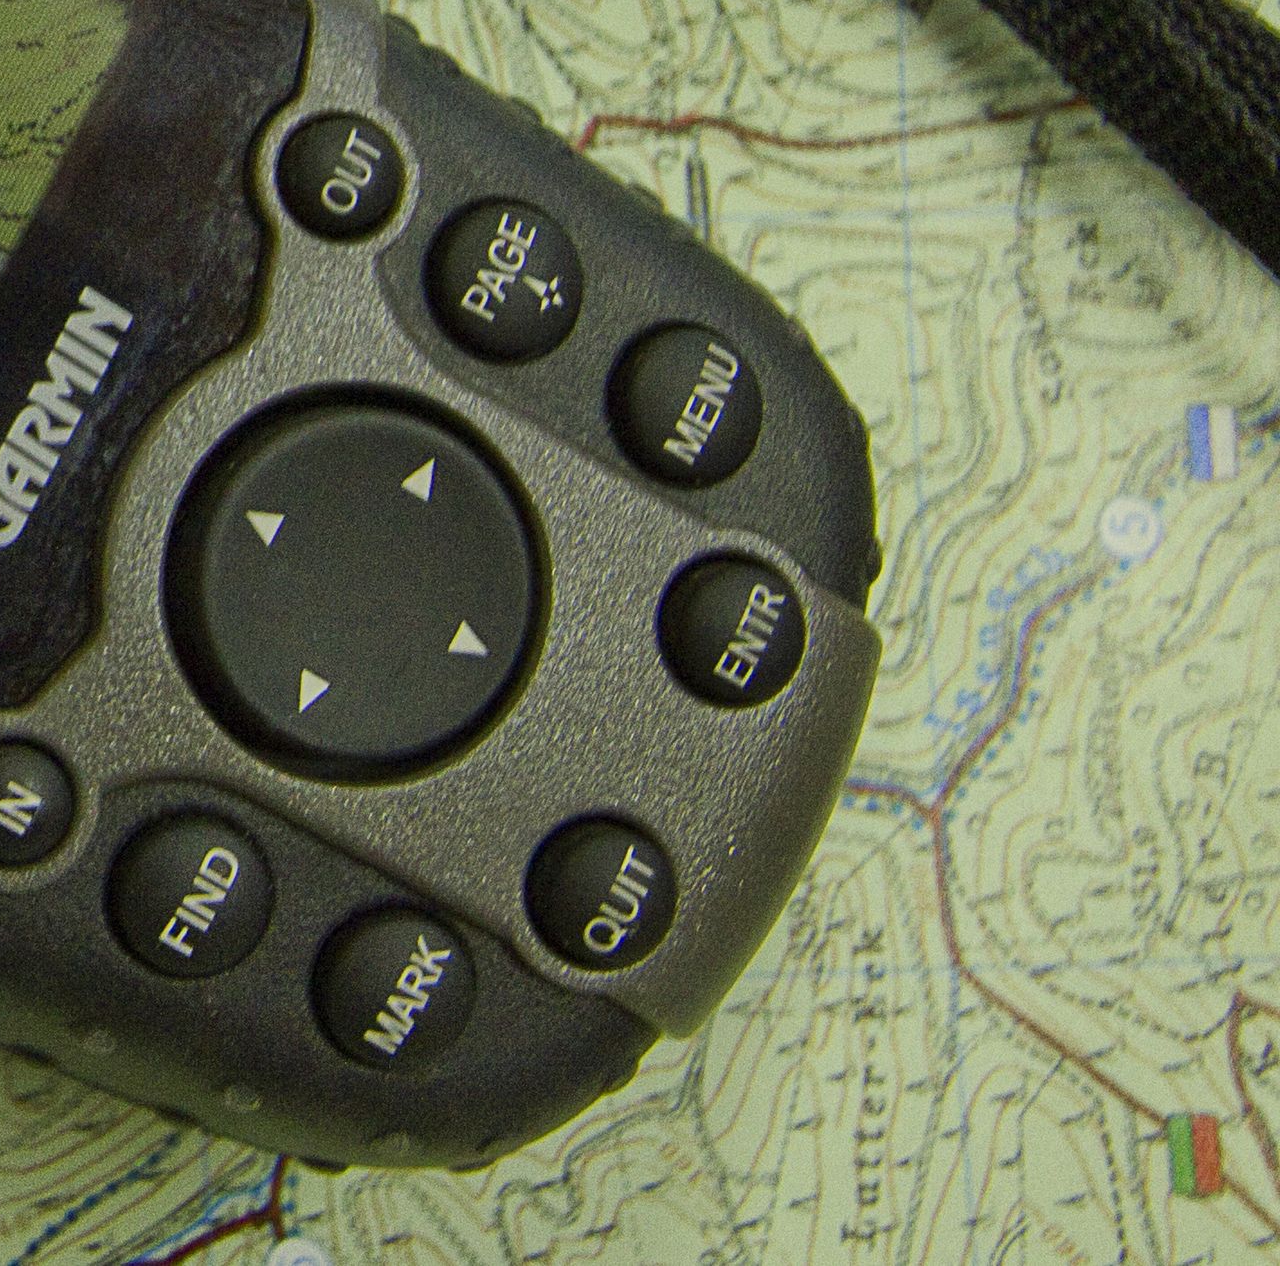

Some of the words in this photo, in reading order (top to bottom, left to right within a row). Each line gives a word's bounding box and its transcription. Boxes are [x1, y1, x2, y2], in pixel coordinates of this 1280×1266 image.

[321, 128, 387, 217] OUT
[461, 212, 537, 322] PAGE
[663, 340, 744, 467] MENU
[713, 582, 787, 690] ENTR
[159, 844, 241, 958] FIND
[582, 843, 657, 955] QUIT
[362, 931, 453, 1059] MARK
